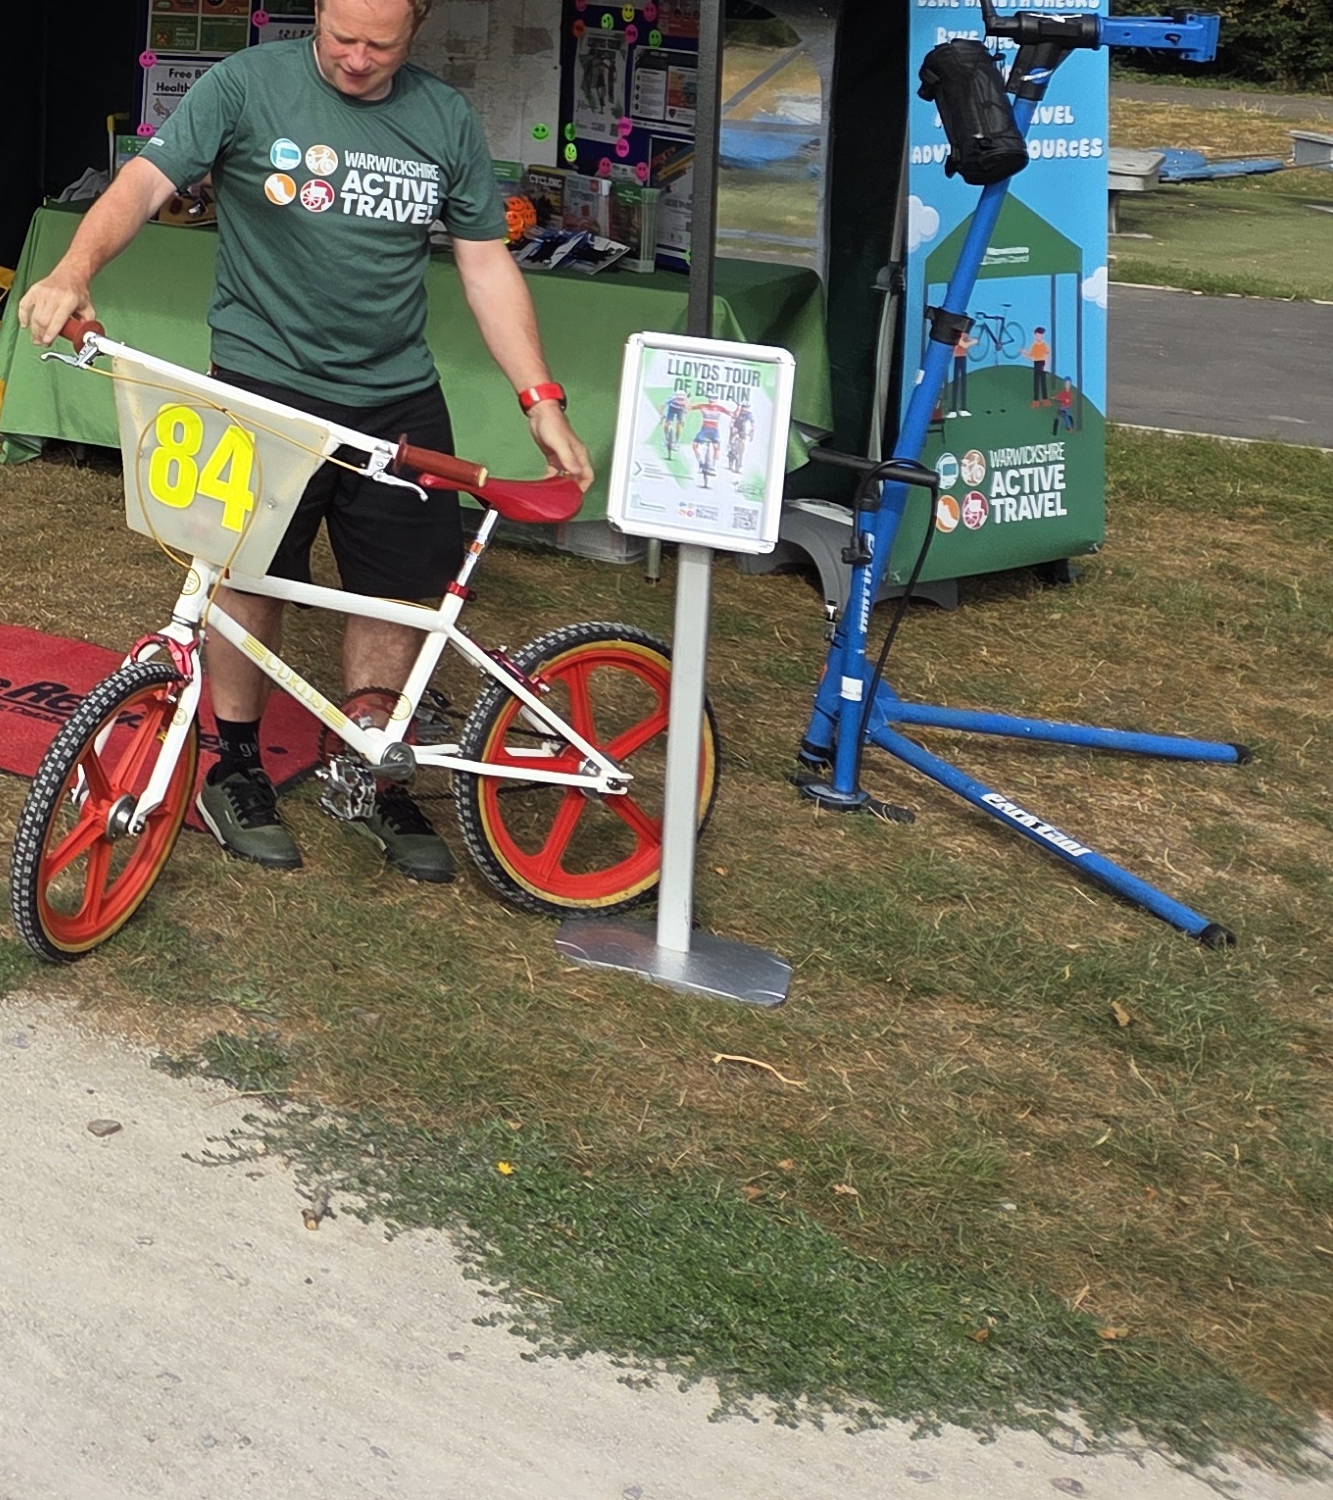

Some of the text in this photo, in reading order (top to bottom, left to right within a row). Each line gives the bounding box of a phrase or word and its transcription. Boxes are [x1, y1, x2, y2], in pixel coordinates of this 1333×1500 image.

[169, 67, 192, 79] Free
[344, 150, 440, 182] WARWICKSHIRE
[341, 169, 439, 204] ACTIVE
[340, 191, 433, 225] TRAVEL
[667, 358, 721, 381] LLOYDS
[725, 366, 761, 388] TOUR
[674, 377, 751, 403] OF BRITAIN
[148, 402, 256, 533] 84
[989, 441, 1066, 468] WARWICKSHIRE
[989, 463, 1066, 498] ACTIVE
[989, 491, 1068, 524] TRAVEL
